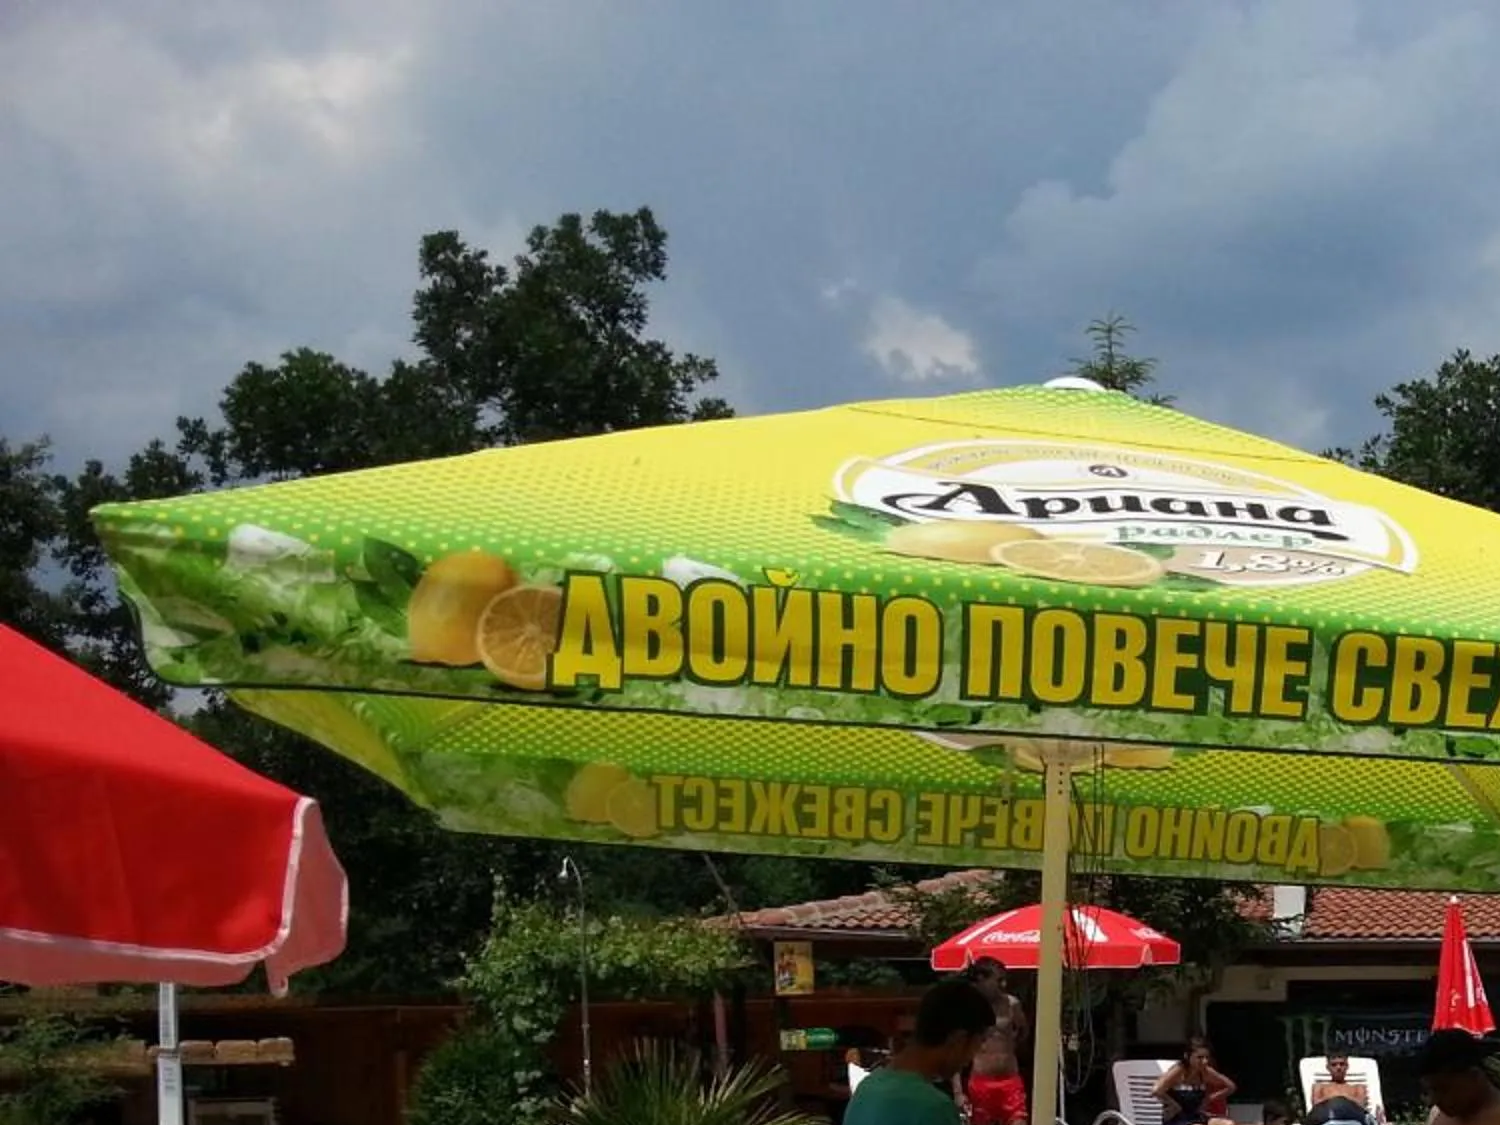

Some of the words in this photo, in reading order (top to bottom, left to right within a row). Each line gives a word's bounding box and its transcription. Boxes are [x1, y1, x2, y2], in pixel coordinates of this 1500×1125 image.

[881, 481, 1335, 526] Ариана
[549, 566, 945, 699] ДВОЙНО
[962, 600, 1312, 721] ПОВЕЧЕ
